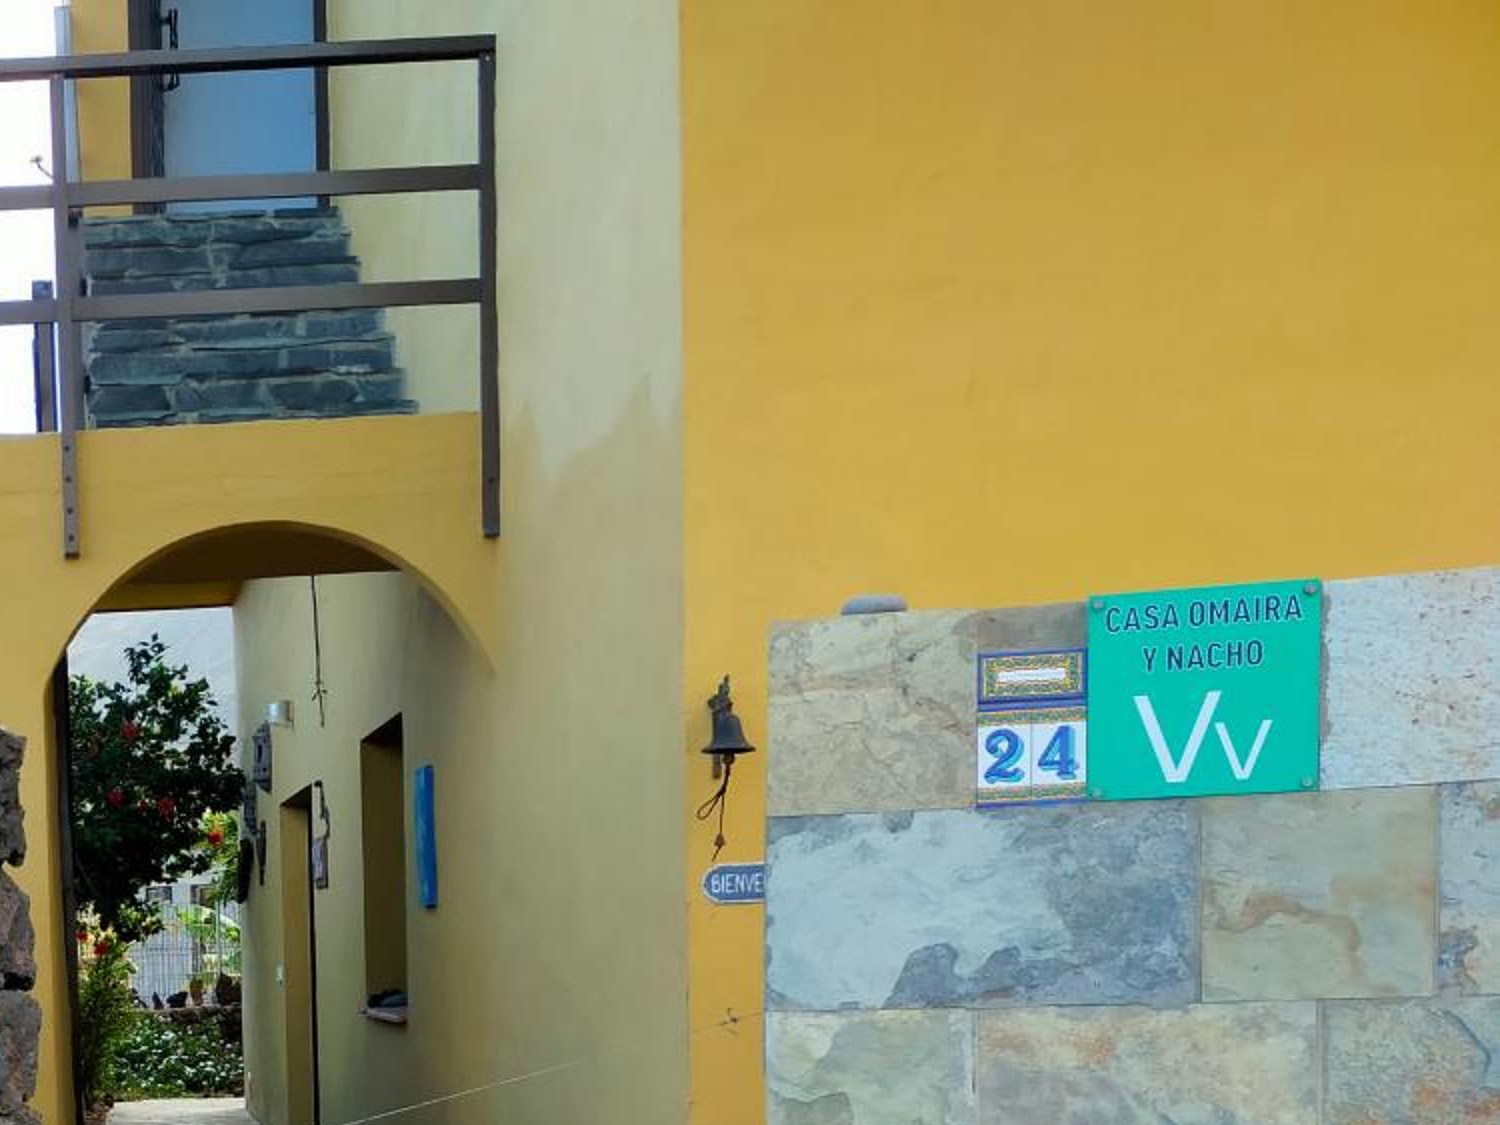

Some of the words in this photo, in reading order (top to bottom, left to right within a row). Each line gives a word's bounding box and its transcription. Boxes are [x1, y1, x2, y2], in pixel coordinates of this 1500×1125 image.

[1106, 606, 1180, 633] CASA
[1189, 594, 1302, 627] OMAIRA
[1143, 647, 1157, 672] Y
[1167, 640, 1263, 671] NACHO
[984, 725, 1080, 784] 24
